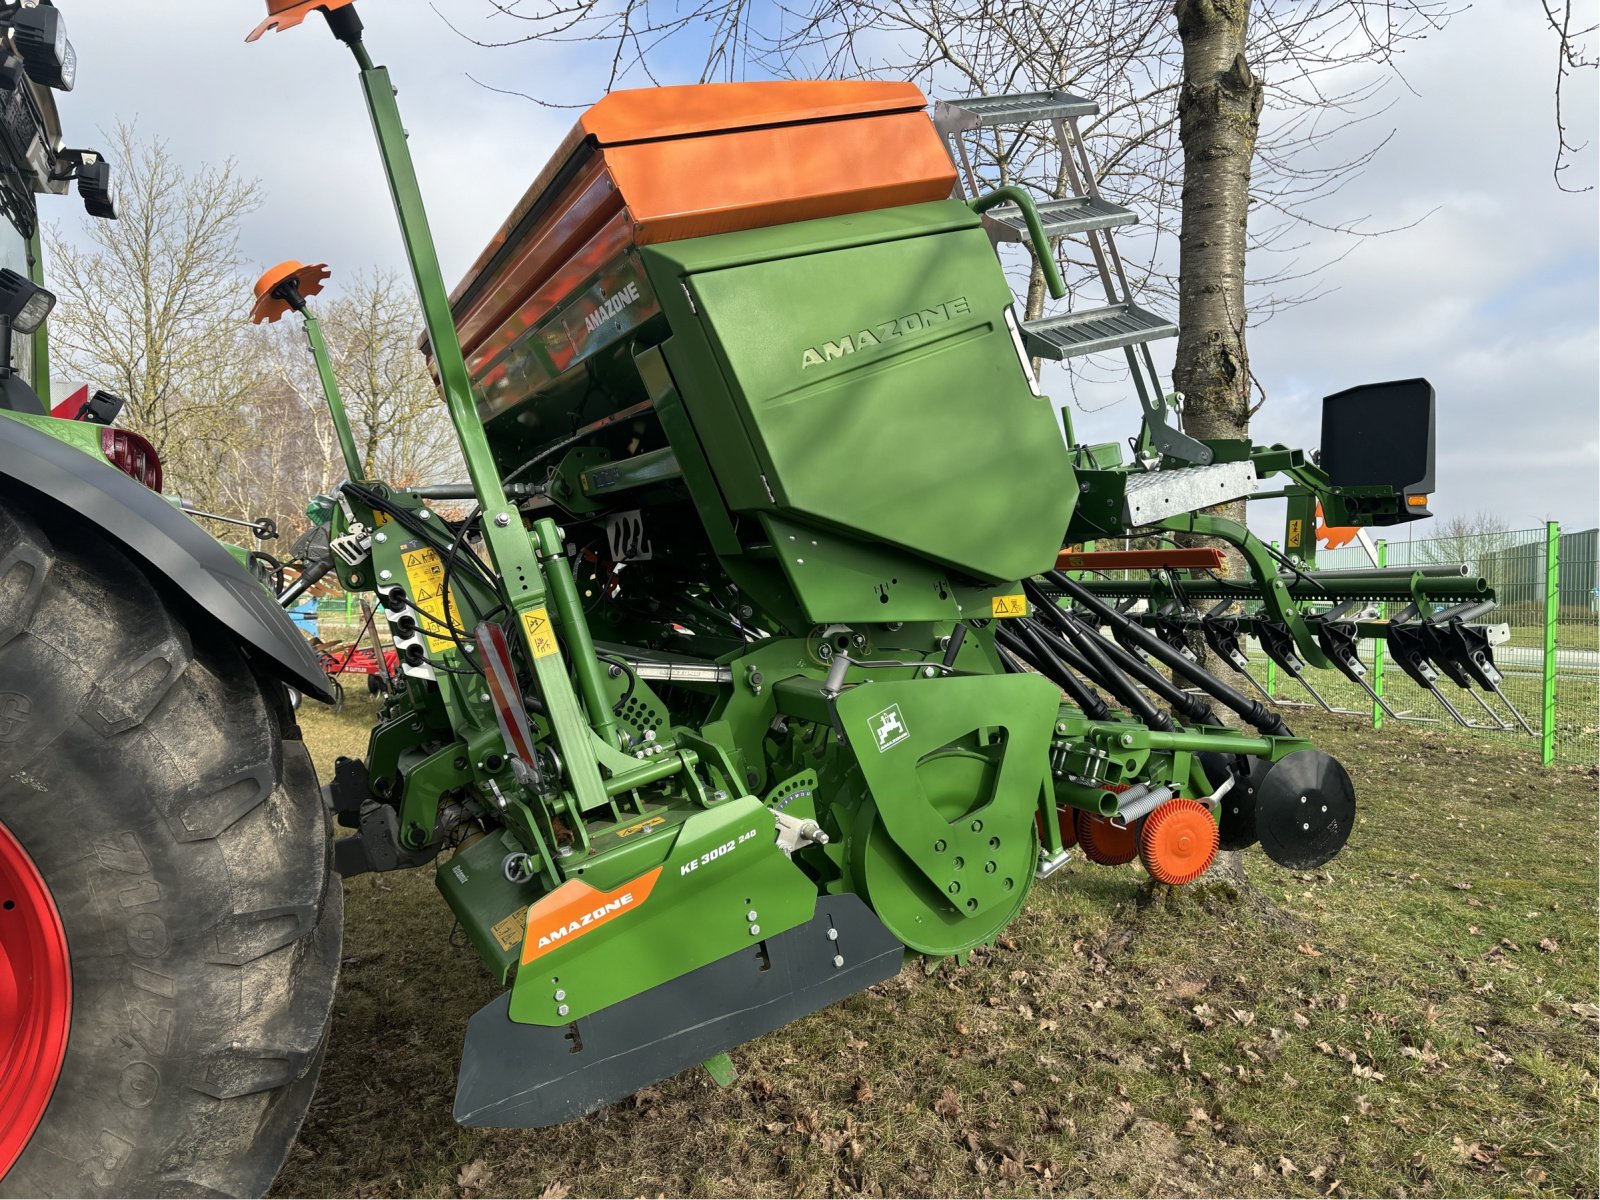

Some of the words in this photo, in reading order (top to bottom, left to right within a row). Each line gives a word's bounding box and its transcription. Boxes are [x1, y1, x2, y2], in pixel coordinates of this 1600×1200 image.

[584, 281, 640, 333] AMAZONE
[801, 296, 971, 370] AMAZONE
[680, 859, 699, 877] KE
[701, 840, 736, 866] 3002
[738, 829, 757, 844] 240
[538, 892, 634, 949] AMAZONE
